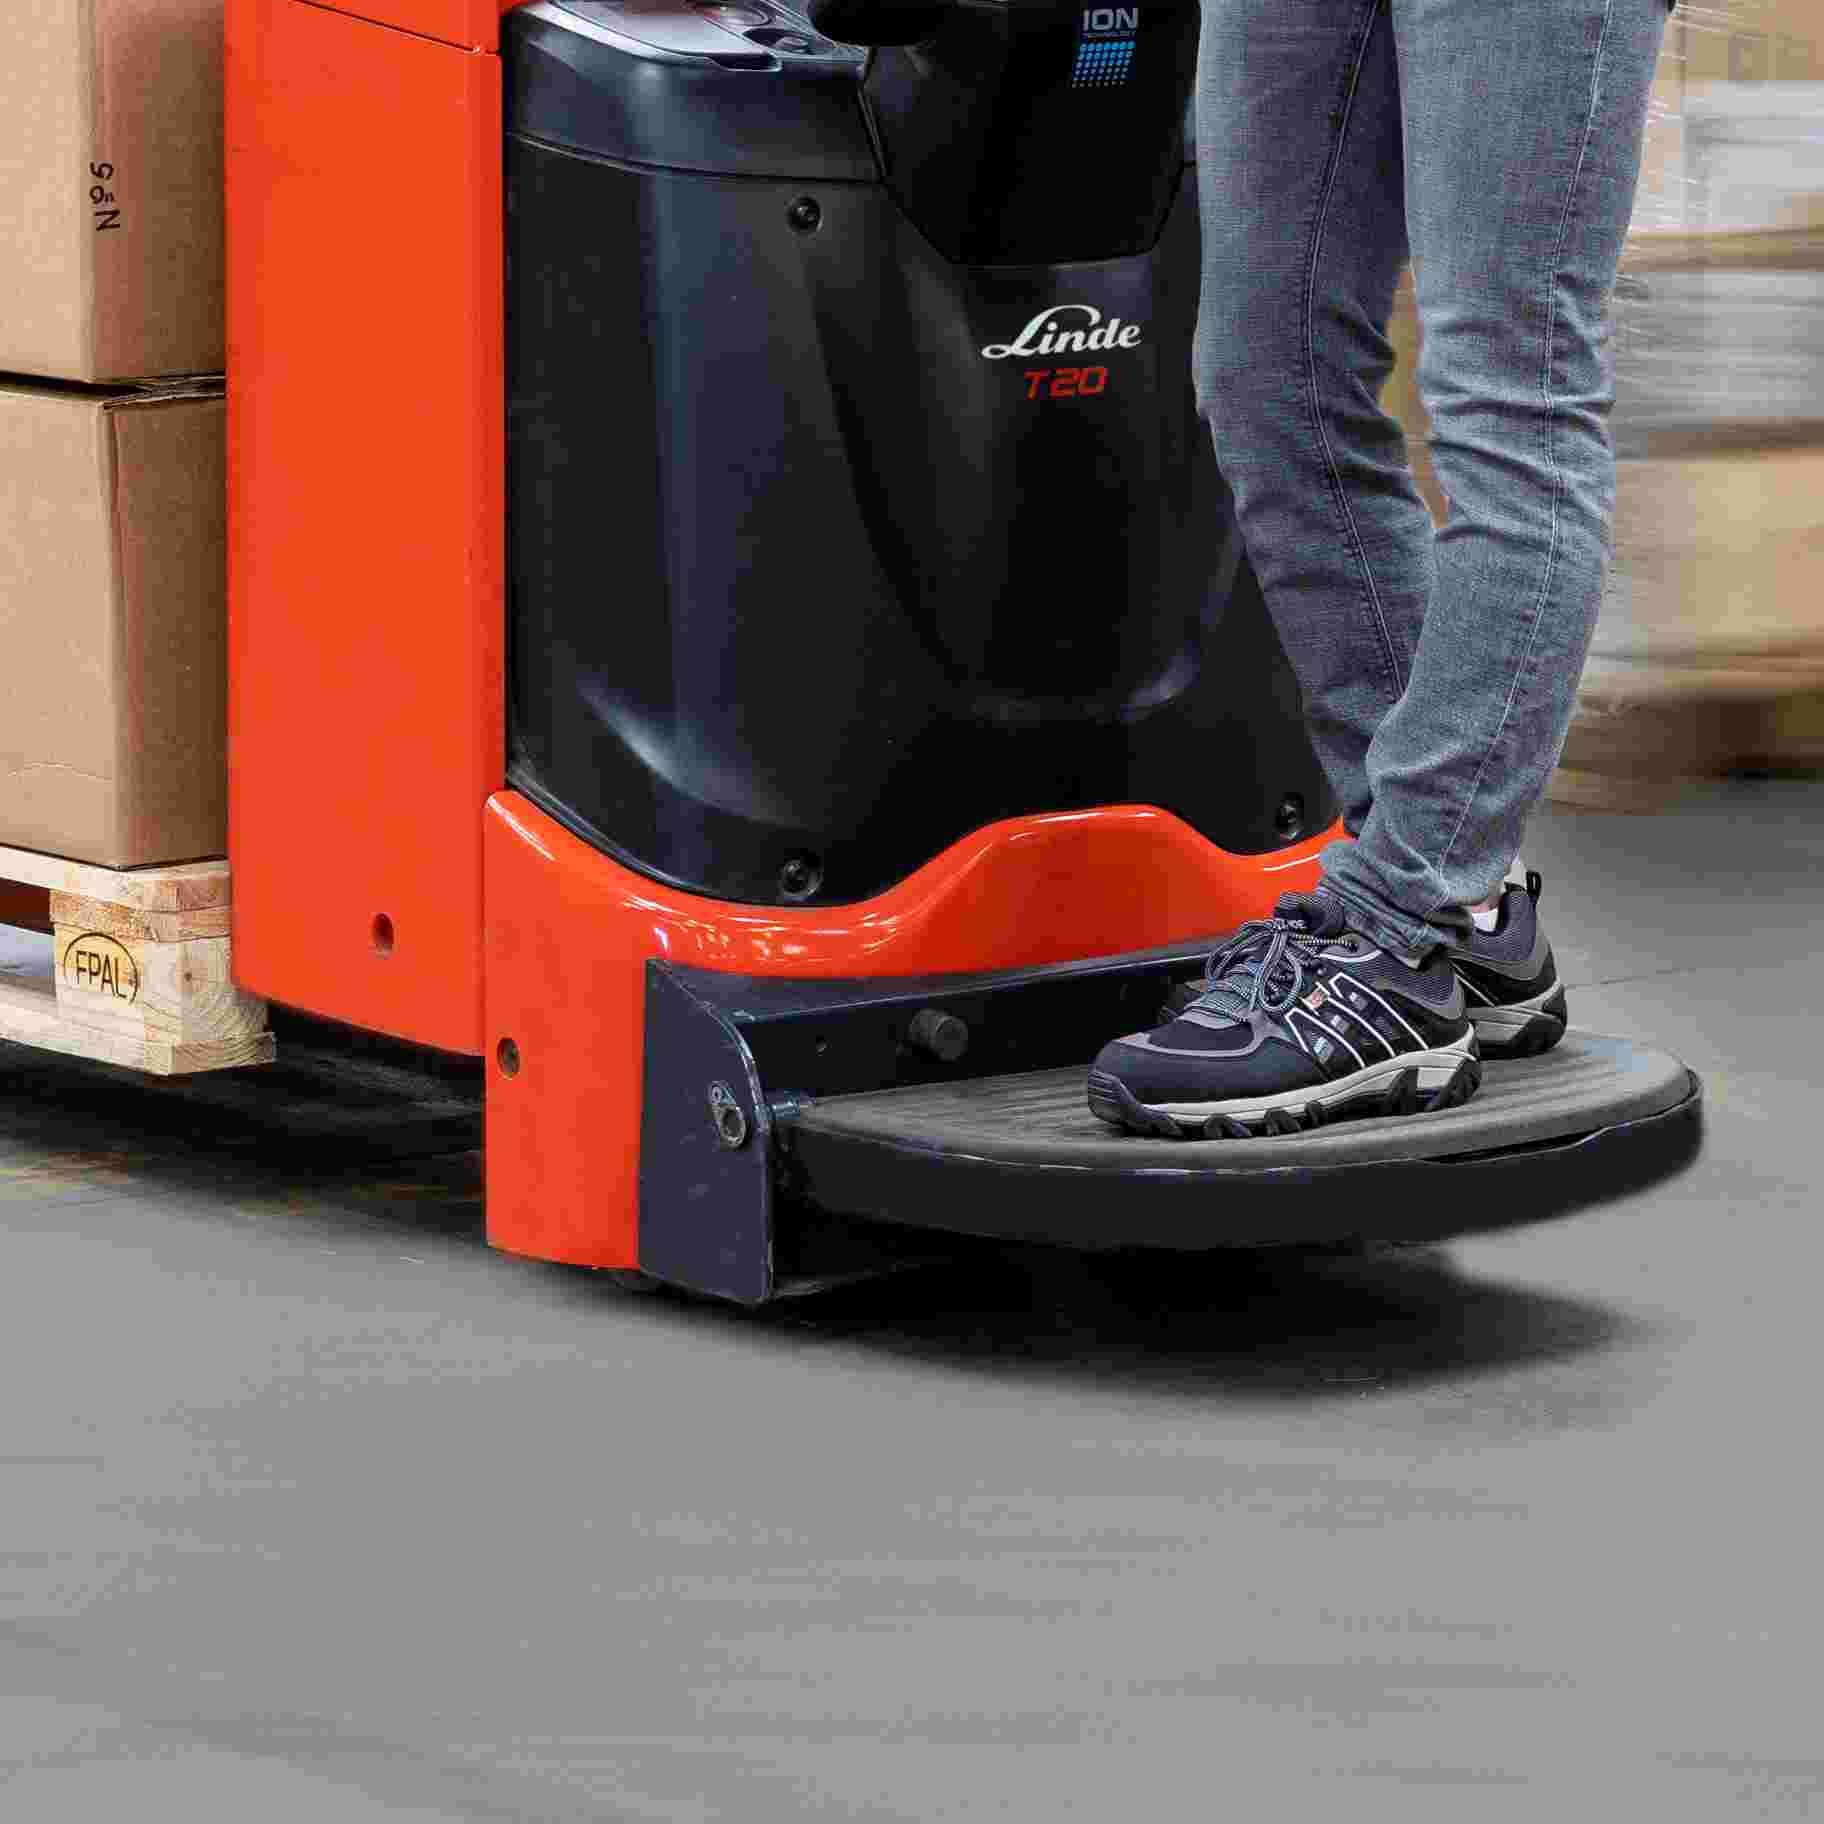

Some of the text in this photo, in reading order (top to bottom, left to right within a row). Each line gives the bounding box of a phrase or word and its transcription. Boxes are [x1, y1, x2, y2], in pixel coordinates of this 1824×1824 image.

[1082, 7, 1138, 31] ION
[981, 304, 1142, 359] Linde
[1023, 366, 1108, 400] T20
